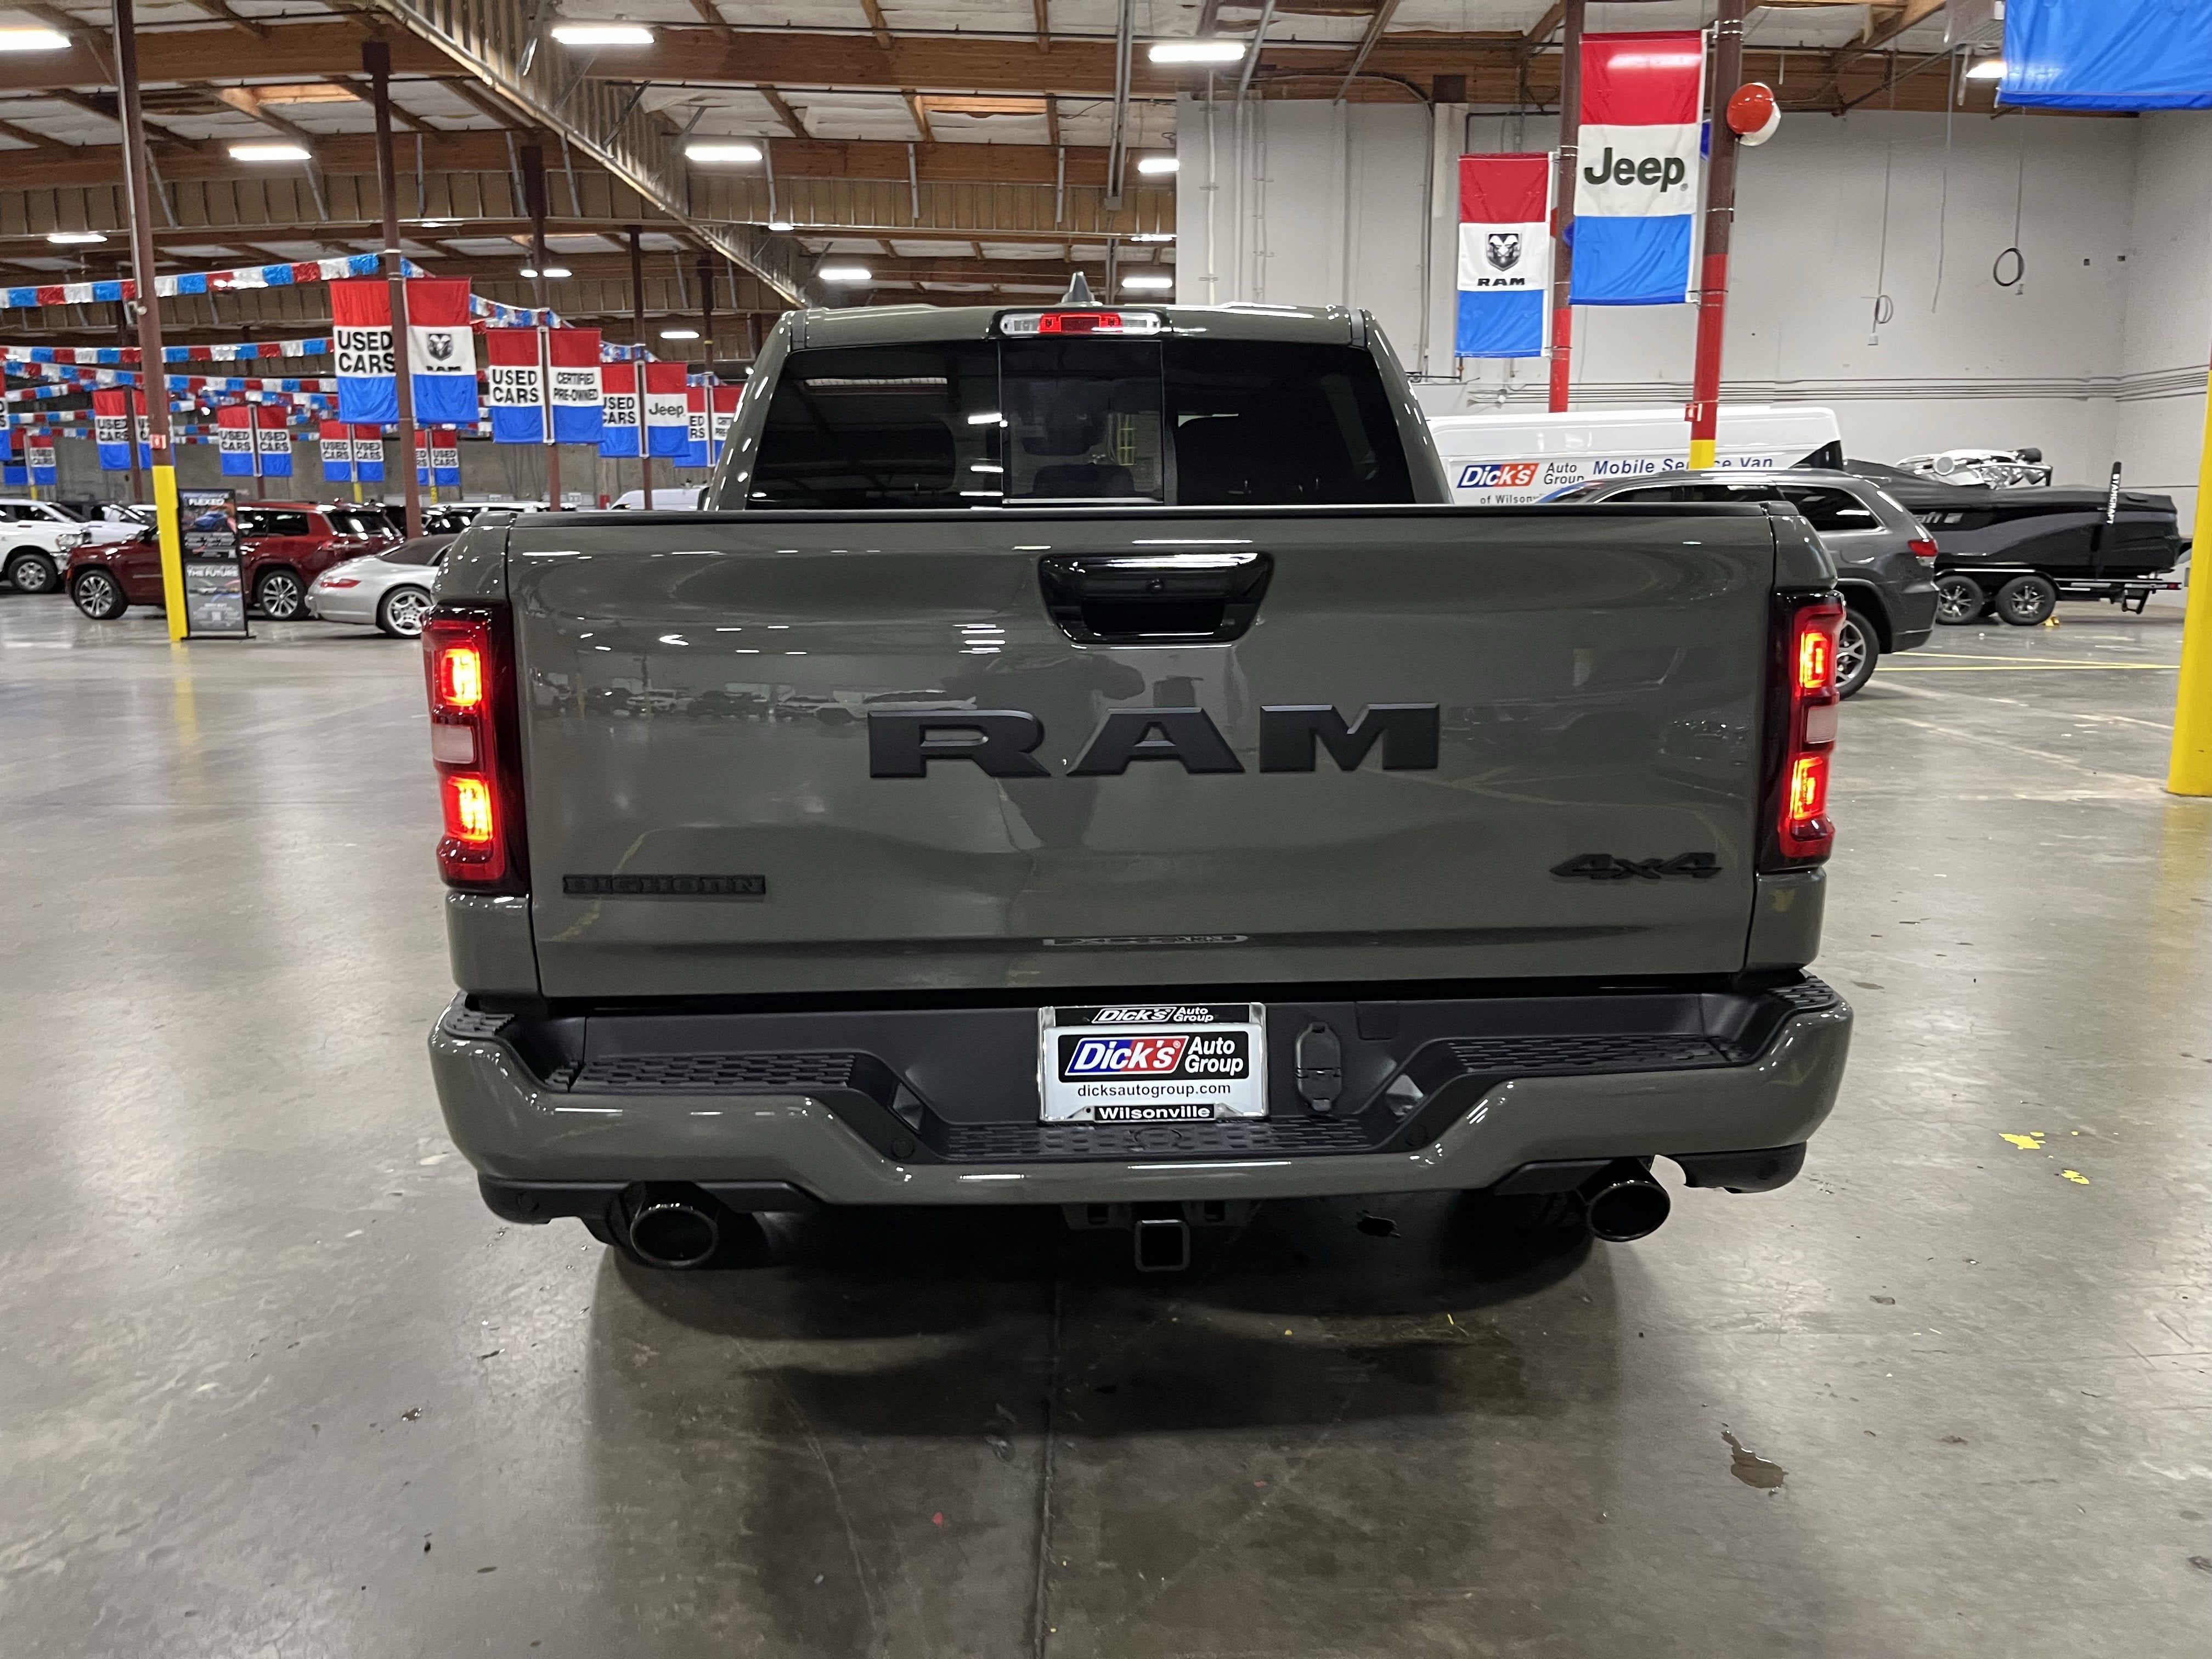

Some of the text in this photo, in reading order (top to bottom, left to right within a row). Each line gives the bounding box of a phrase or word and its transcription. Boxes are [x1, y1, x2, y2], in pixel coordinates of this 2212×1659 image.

[1584, 147, 1685, 193] Jeep
[1477, 278, 1525, 286] RAM
[338, 330, 393, 351] USED
[338, 353, 394, 374] CARS
[493, 369, 537, 386] USED
[493, 387, 539, 403] CARS
[649, 403, 684, 417] Jeep
[221, 431, 250, 440] USED
[259, 431, 287, 441] USED
[221, 442, 251, 450] CARS
[260, 442, 289, 452] CARS
[1546, 462, 1577, 473] Auto
[1593, 459, 1655, 475] Mobile
[1740, 457, 1773, 467] Van
[1461, 465, 1529, 486] Dick's
[1480, 495, 1491, 504] of
[868, 703, 1440, 778] RAM
[1098, 1008, 1167, 1021] Dick's
[1173, 1014, 1214, 1022] Group
[1188, 1036, 1235, 1055] Auto
[1074, 1040, 1175, 1070] Dick's
[1184, 1055, 1244, 1076] Group
[1077, 1084, 1231, 1097] dicksautogroup.com
[1099, 1106, 1210, 1120] Wilsonville
